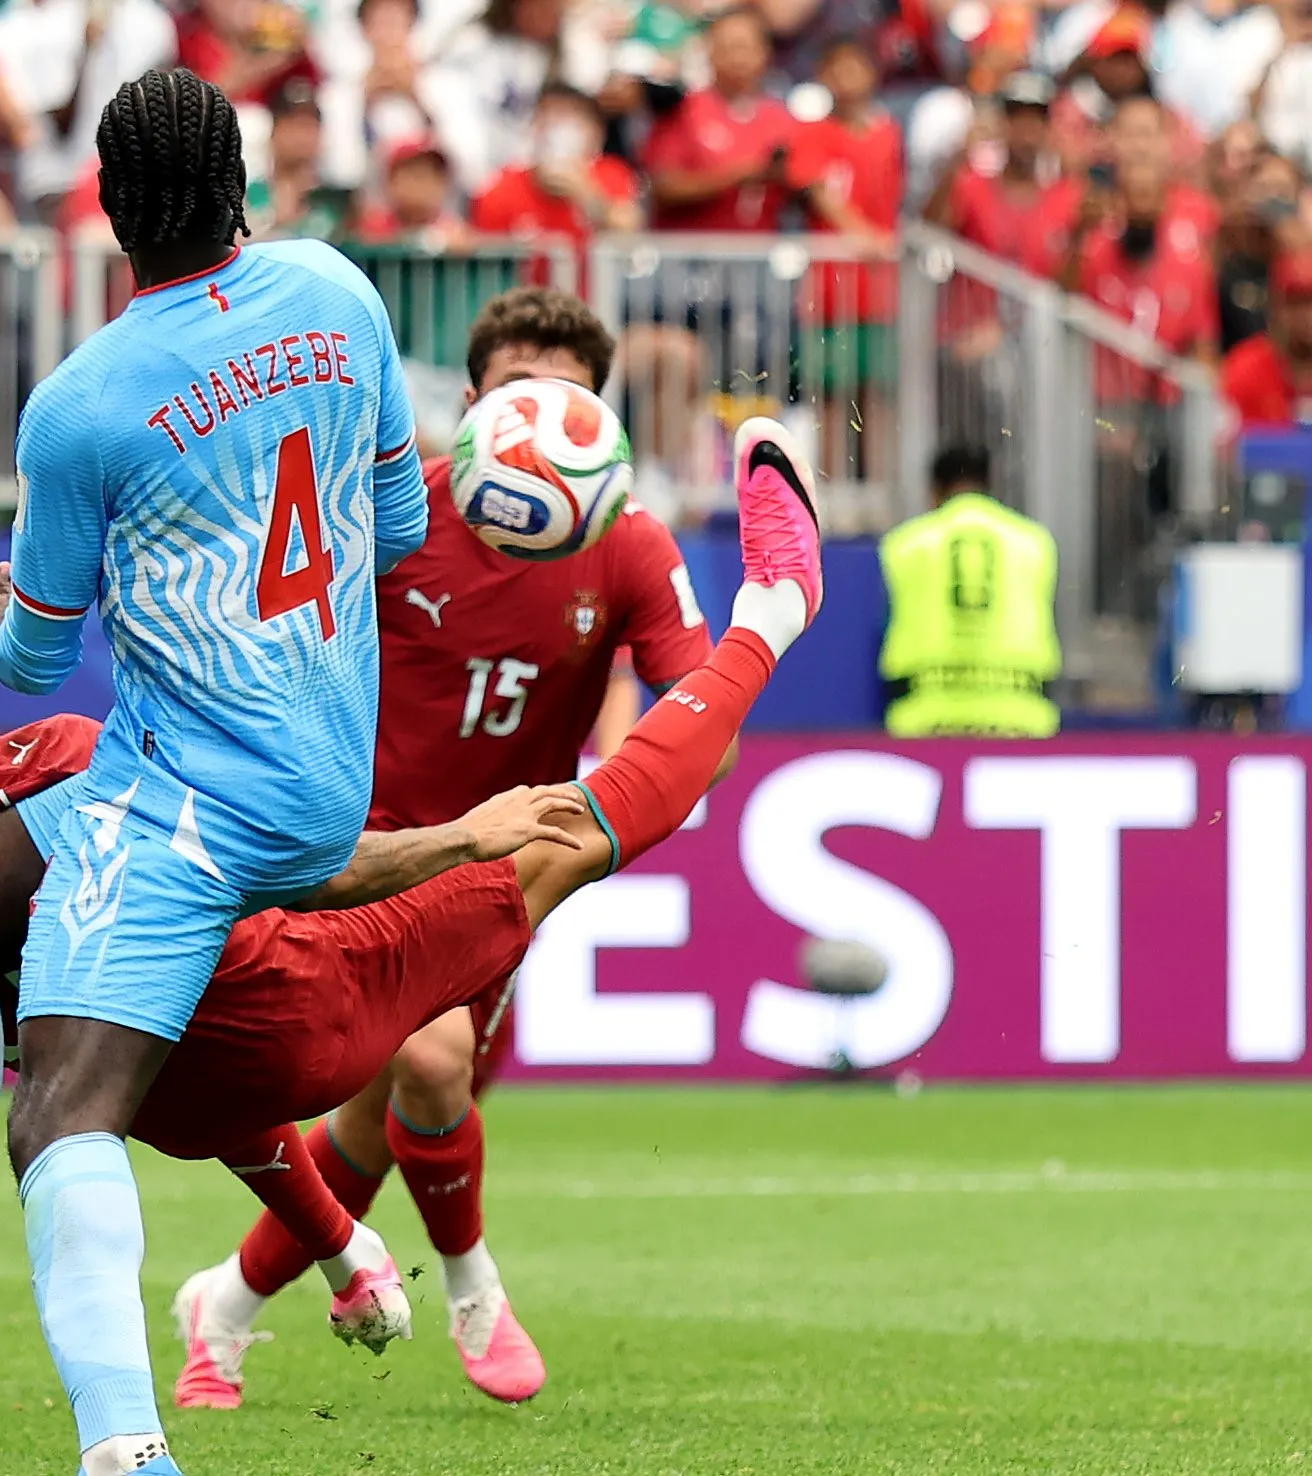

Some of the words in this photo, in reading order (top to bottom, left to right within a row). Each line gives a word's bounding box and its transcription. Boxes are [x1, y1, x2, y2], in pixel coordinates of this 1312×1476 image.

[146, 331, 356, 454] TUANZEBE
[255, 424, 336, 642] 4
[459, 656, 539, 738] 15
